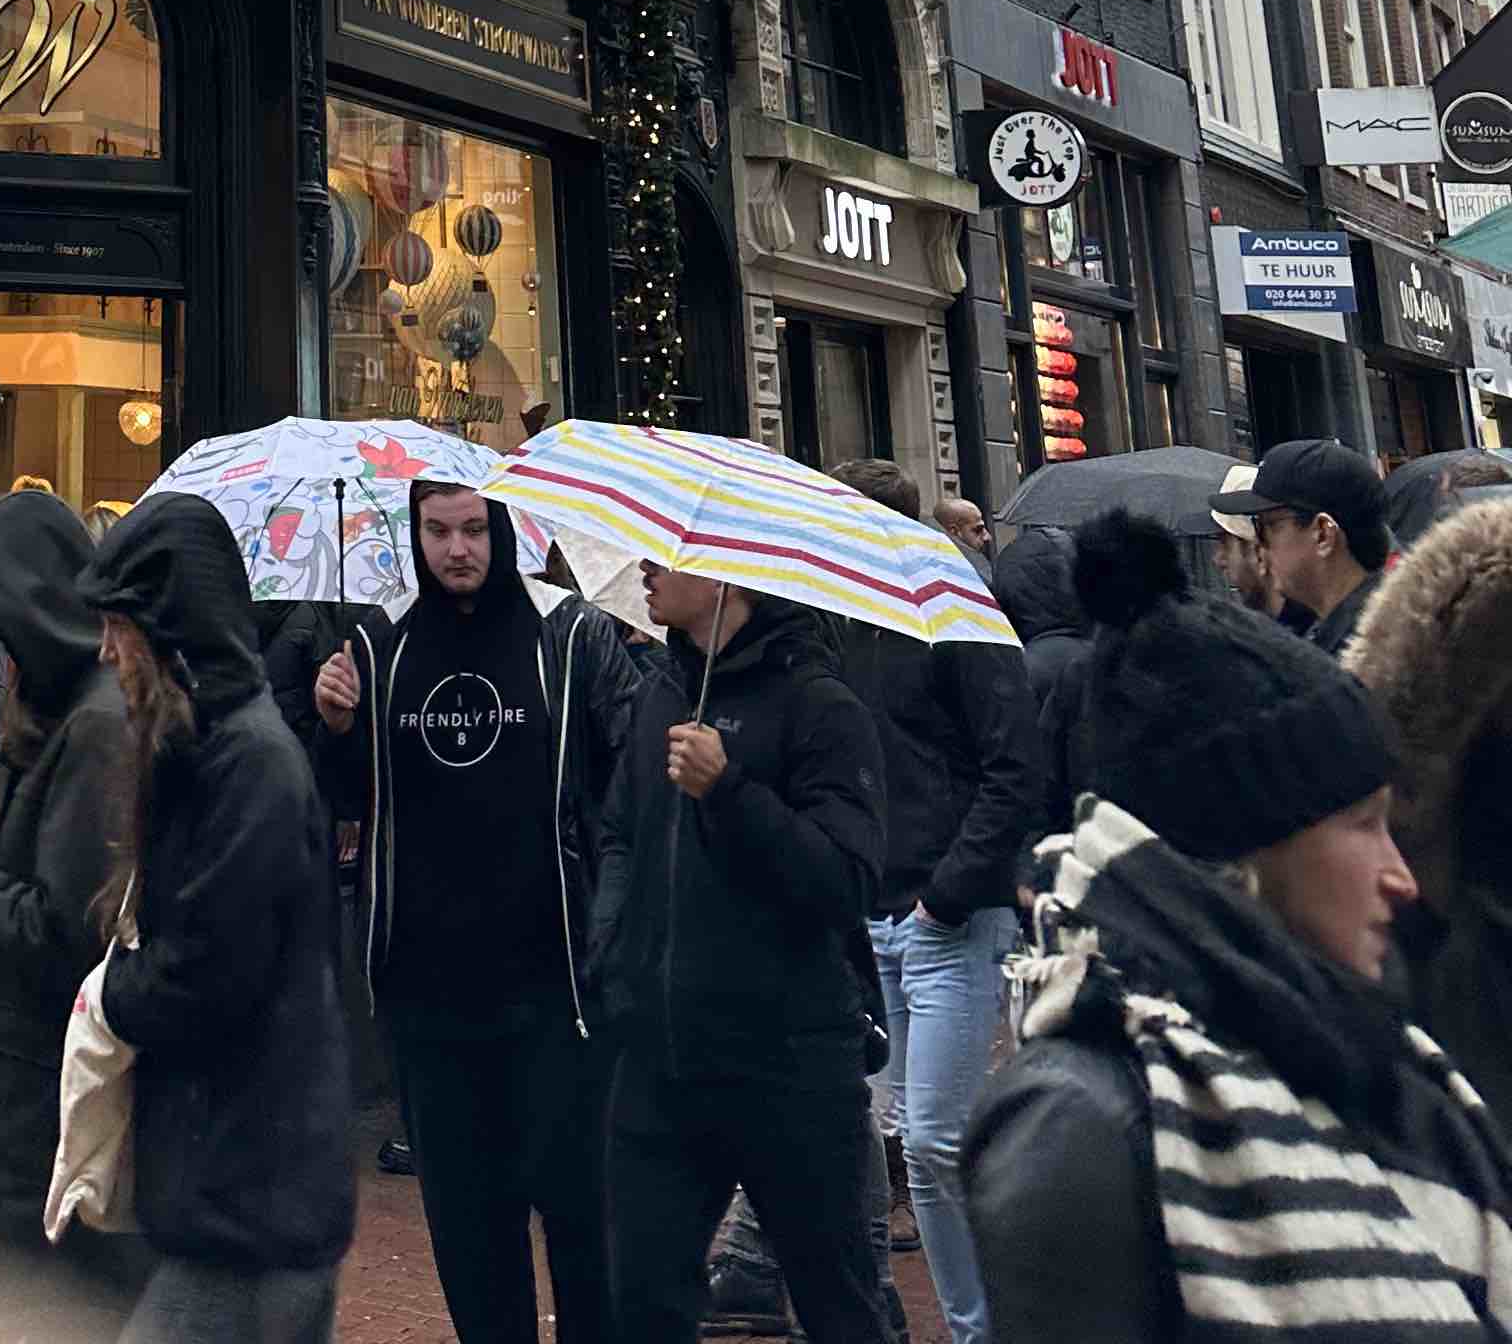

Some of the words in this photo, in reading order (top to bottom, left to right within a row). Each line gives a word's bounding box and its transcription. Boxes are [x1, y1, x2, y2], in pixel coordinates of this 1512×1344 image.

[1051, 27, 1120, 109] JOTT
[1326, 117, 1433, 134] MAC
[993, 134, 1007, 162] Just
[1004, 115, 1034, 133] Over
[1040, 115, 1063, 135] The
[1062, 136, 1074, 161] Top
[1021, 184, 1056, 196] JOTT
[823, 187, 892, 266] JOTT
[53, 241, 81, 257] Since
[81, 246, 105, 258] 1907
[1251, 237, 1339, 251] Ambuco
[1260, 264, 1281, 278] TE
[1286, 264, 1337, 278] HUUR
[1265, 289, 1285, 299] 020
[1309, 289, 1322, 299] 30
[1324, 289, 1337, 300] 35
